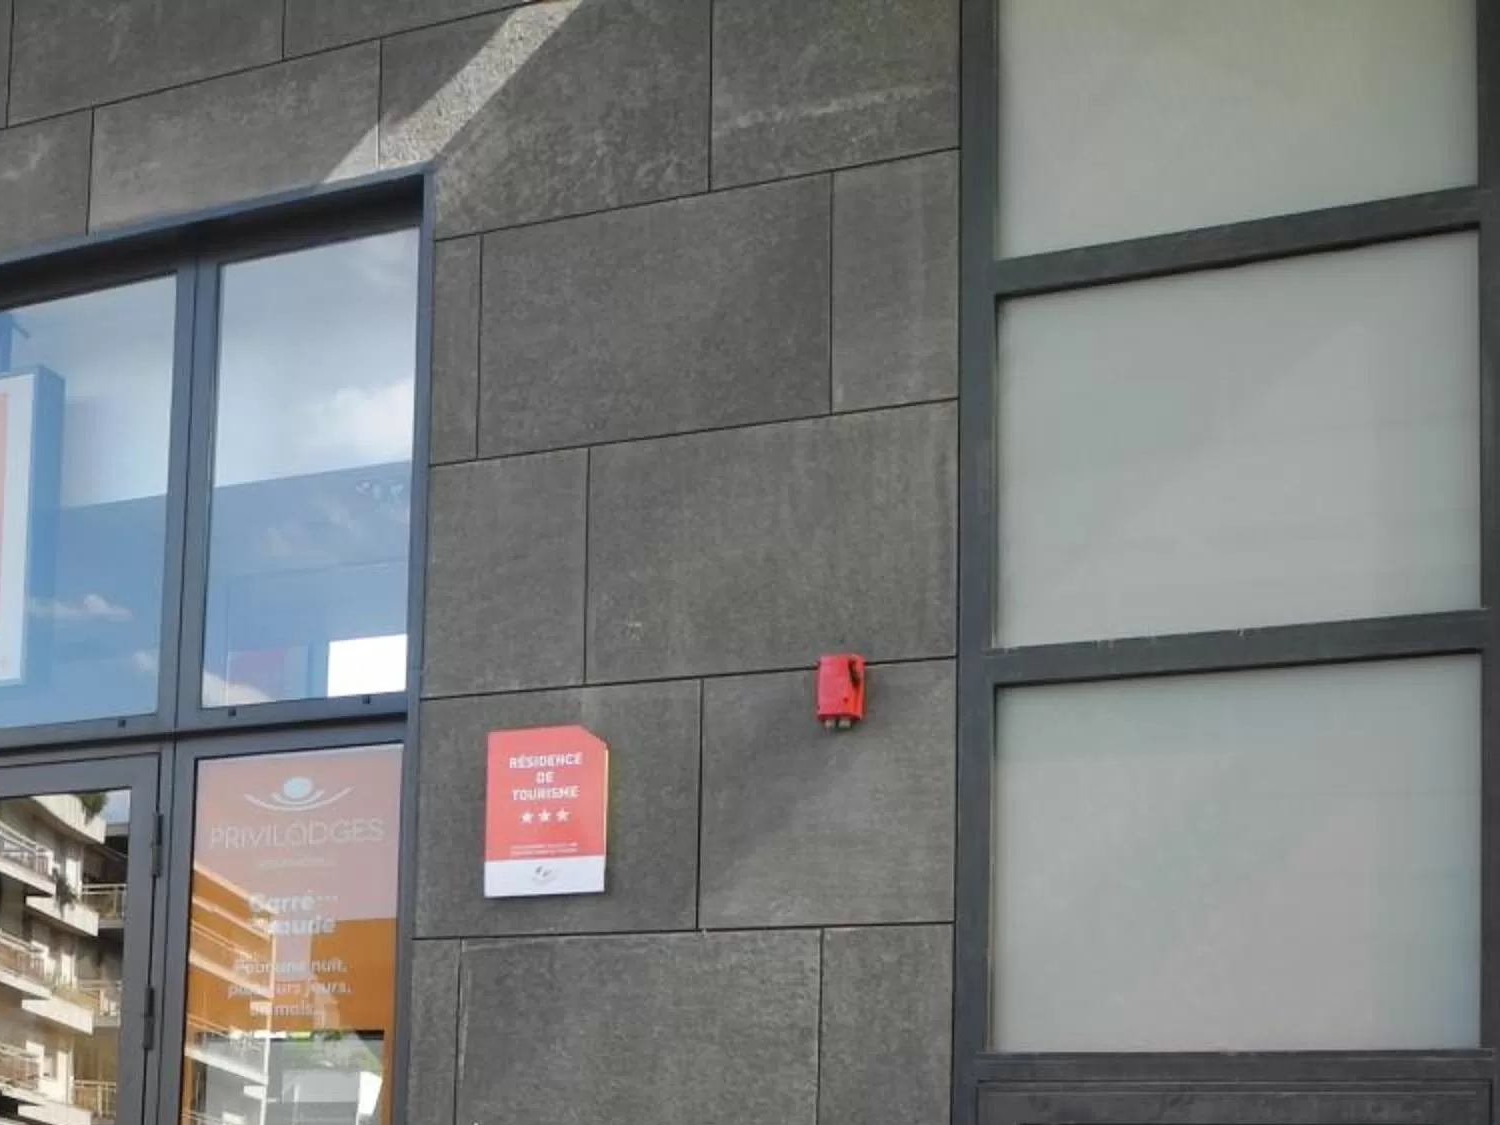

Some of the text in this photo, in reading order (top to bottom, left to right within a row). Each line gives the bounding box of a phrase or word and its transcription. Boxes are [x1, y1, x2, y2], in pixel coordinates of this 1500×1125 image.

[509, 751, 582, 769] RÉSIDENCE
[536, 771, 555, 784] DE
[512, 785, 580, 801] TOURISME
[209, 818, 385, 850] PRIVILODGES
